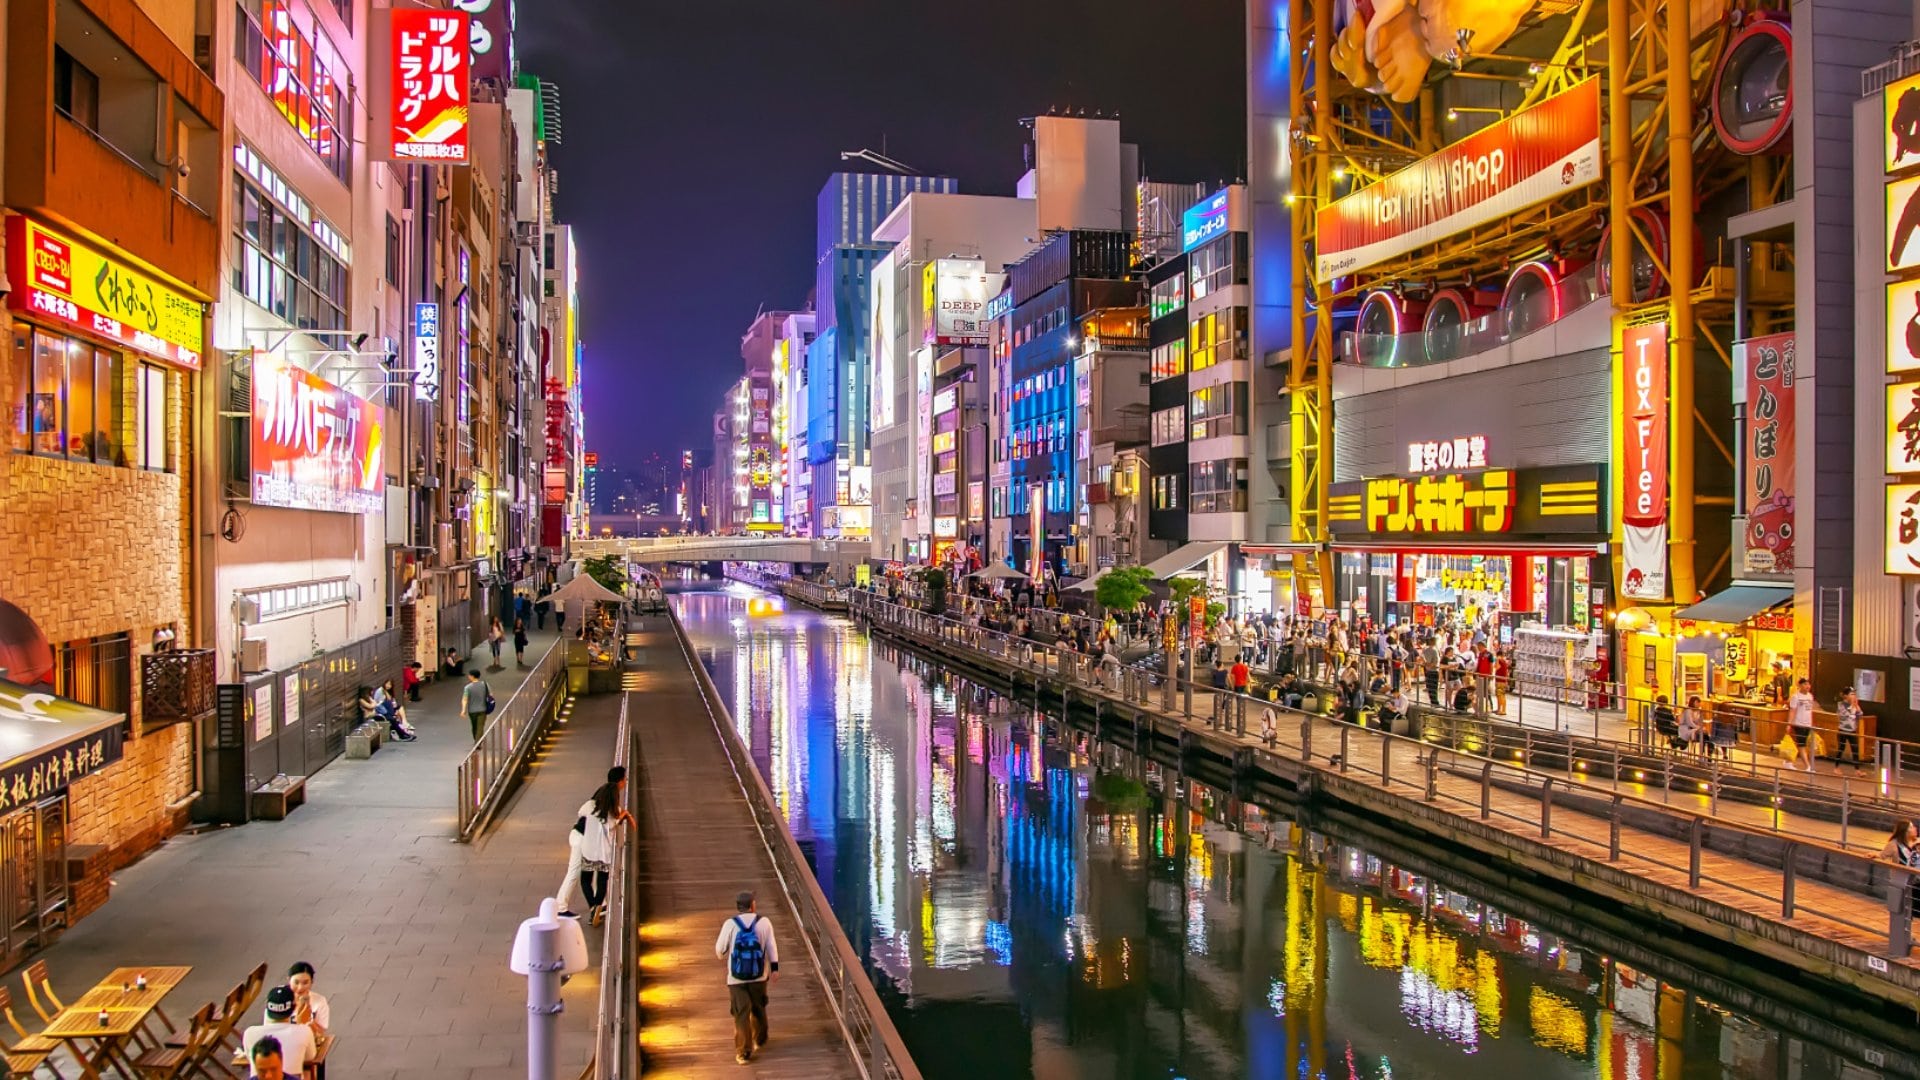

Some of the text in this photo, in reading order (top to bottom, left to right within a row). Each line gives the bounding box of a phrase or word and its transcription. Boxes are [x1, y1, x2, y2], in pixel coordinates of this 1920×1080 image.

[400, 31, 427, 122] ドラッグ
[428, 18, 460, 101] ツルハ
[95, 261, 158, 332] くれおーる
[421, 306, 436, 336] 焼肉
[942, 302, 982, 311] DEEP
[1635, 339, 1652, 514] Tax Free
[1754, 346, 1779, 499] とんぼり
